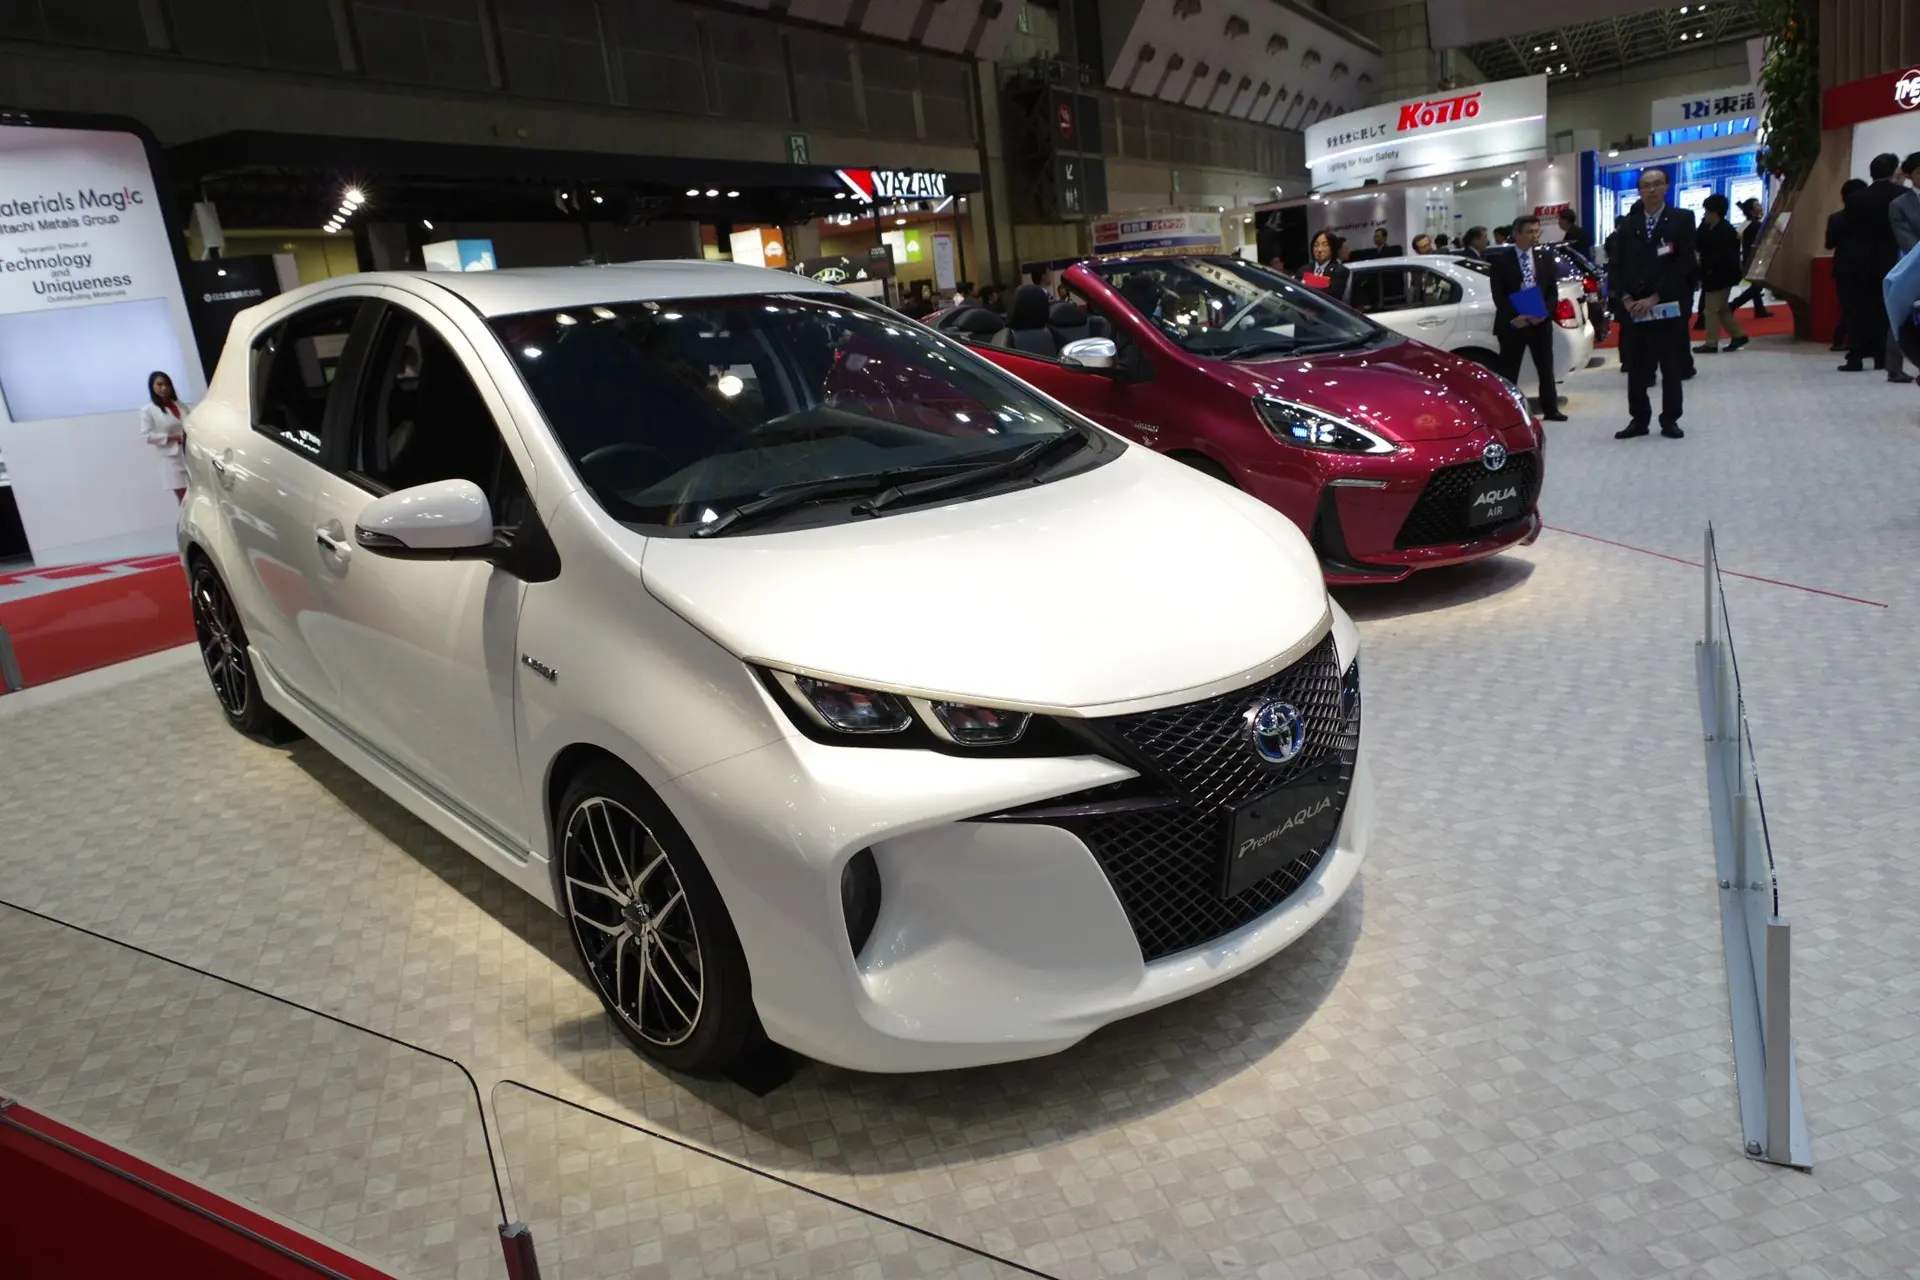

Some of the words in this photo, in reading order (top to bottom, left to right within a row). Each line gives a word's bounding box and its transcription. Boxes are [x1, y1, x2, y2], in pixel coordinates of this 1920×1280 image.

[1358, 155, 1374, 164] Your
[1375, 150, 1400, 161] Safety
[872, 170, 947, 198] YAZAK
[0, 192, 75, 217] aterials
[38, 217, 79, 231] Metals
[82, 213, 120, 227] Group
[51, 267, 70, 278] and
[33, 274, 132, 295] Uniqueness
[1472, 486, 1517, 508] AQUA
[1486, 505, 1503, 518] AIR
